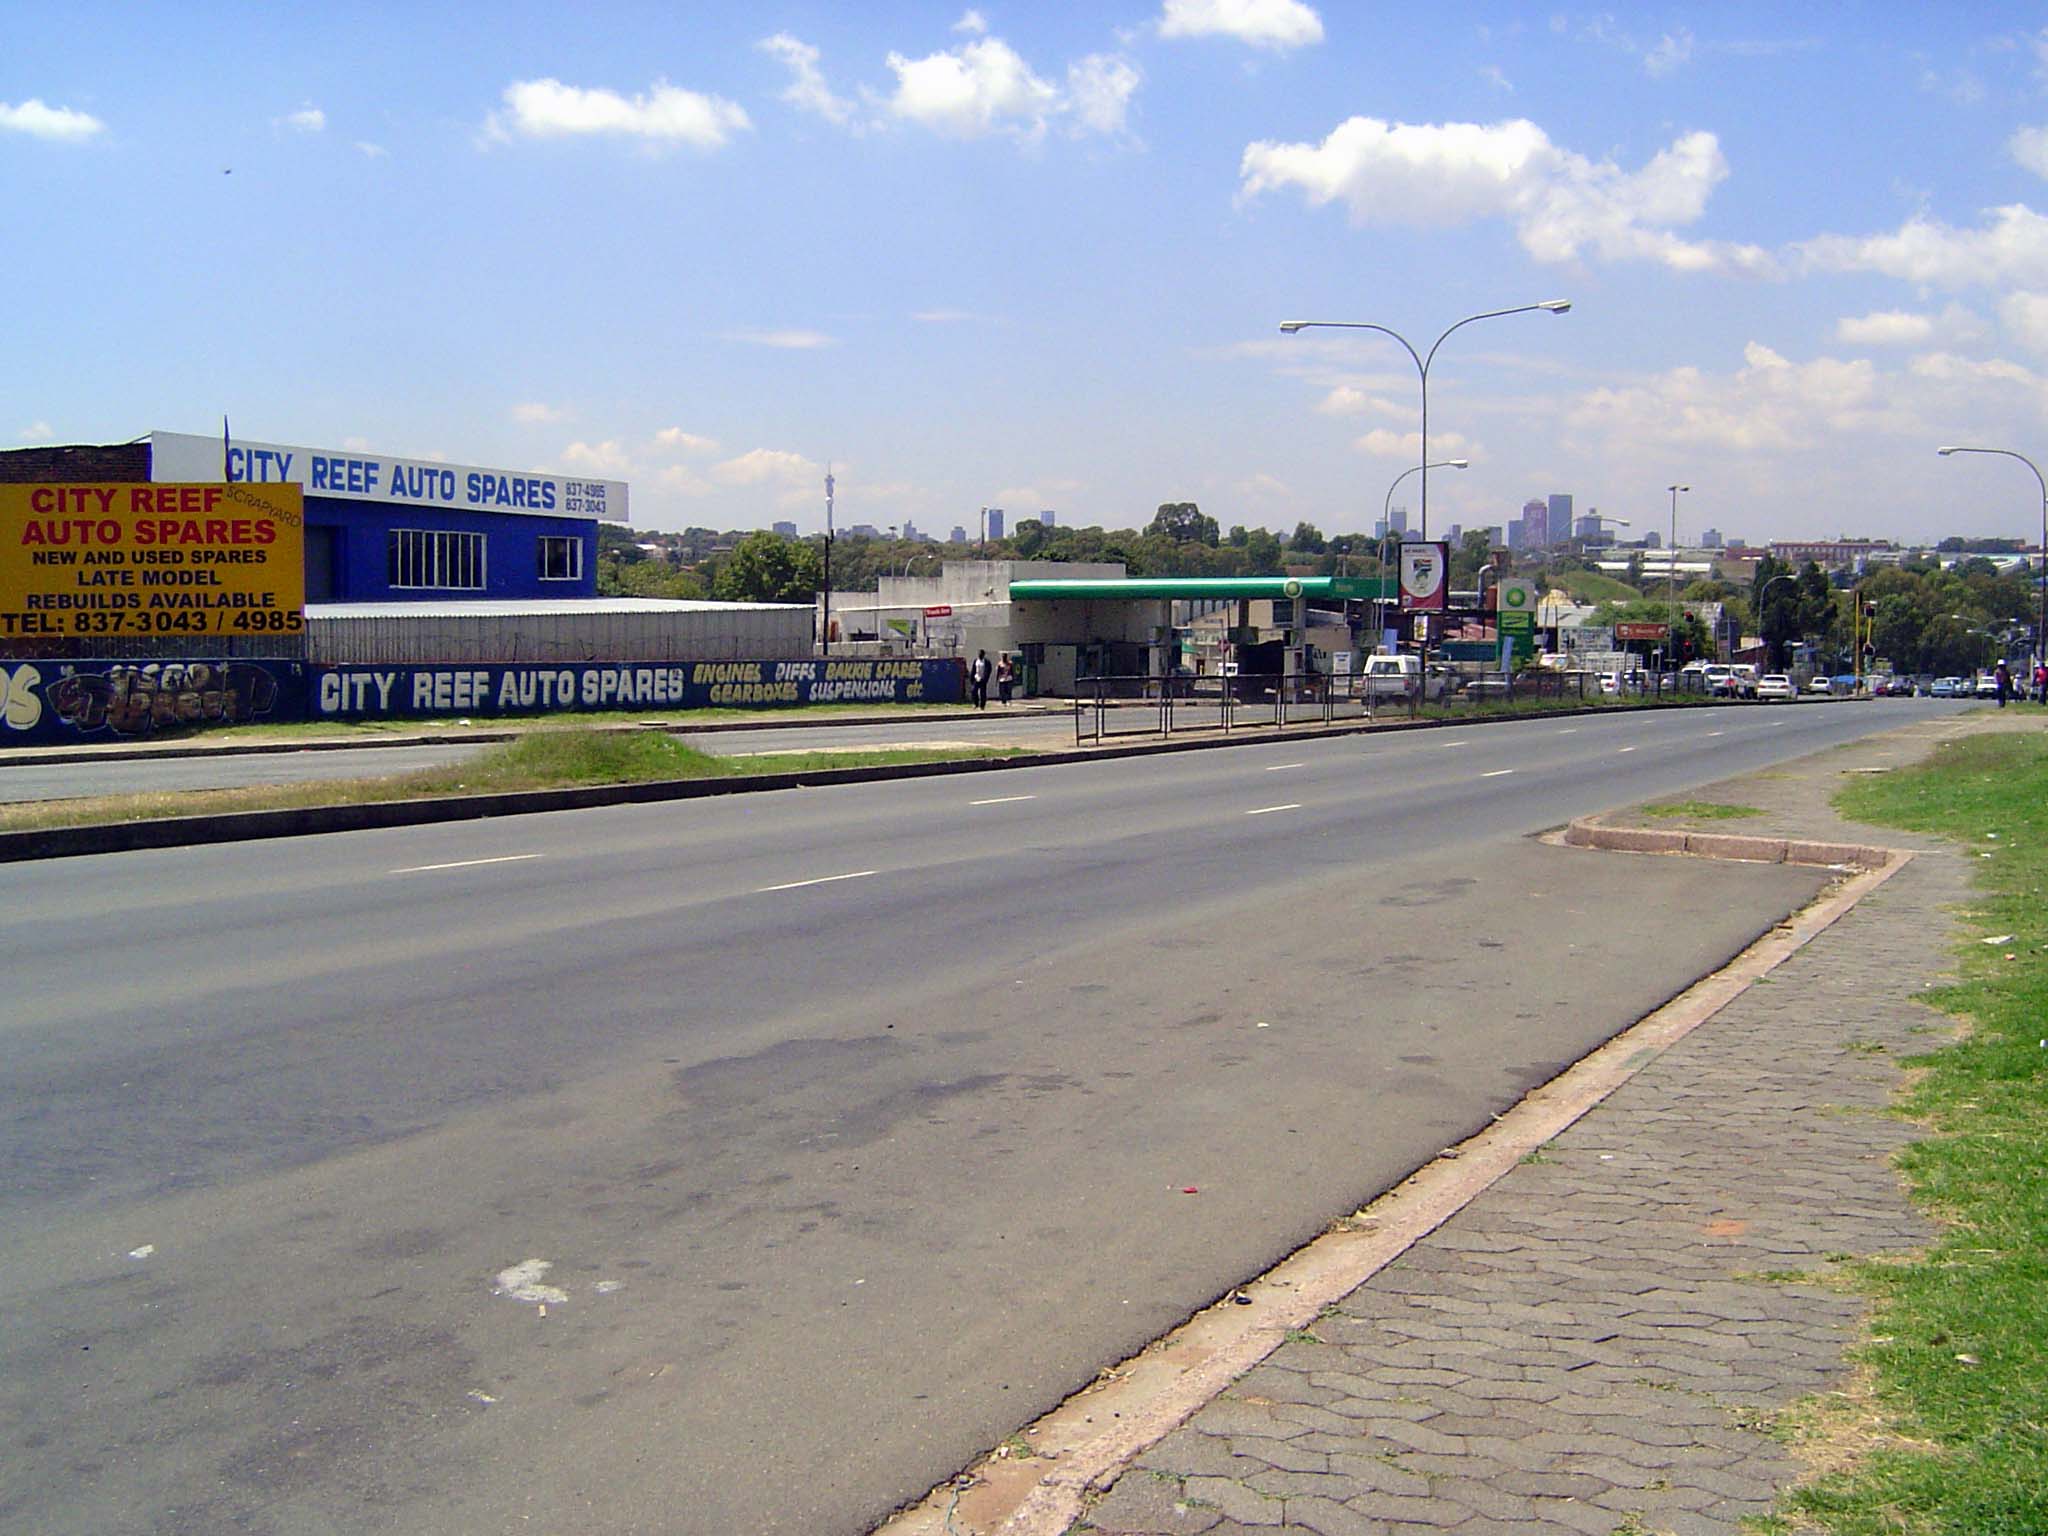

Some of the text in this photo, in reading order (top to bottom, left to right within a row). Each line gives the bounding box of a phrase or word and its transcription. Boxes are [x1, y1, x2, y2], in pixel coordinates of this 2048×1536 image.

[227, 448, 556, 510] CITY REEF AUTO SPARES
[565, 482, 606, 498] 837-4985
[31, 488, 223, 513] CITY REEF
[226, 485, 302, 528] SCRAPYARD
[565, 497, 606, 514] 837-3043
[21, 519, 277, 545] AUTO SPARES
[32, 550, 267, 565] NEW AND USED SPARES
[77, 570, 222, 586] LATE MODEL
[27, 592, 276, 609] REBUILDS AVAILABLE
[1, 613, 65, 632] TEL:
[74, 612, 207, 632] 837-3043
[233, 611, 302, 631] 4985
[692, 661, 923, 683] ENGINES DIFFS BAKKIE SPARES
[320, 668, 684, 711] CITY REEF AUTO SPARES
[709, 680, 924, 703] GEARBOXES SUSPENSIONS etc
